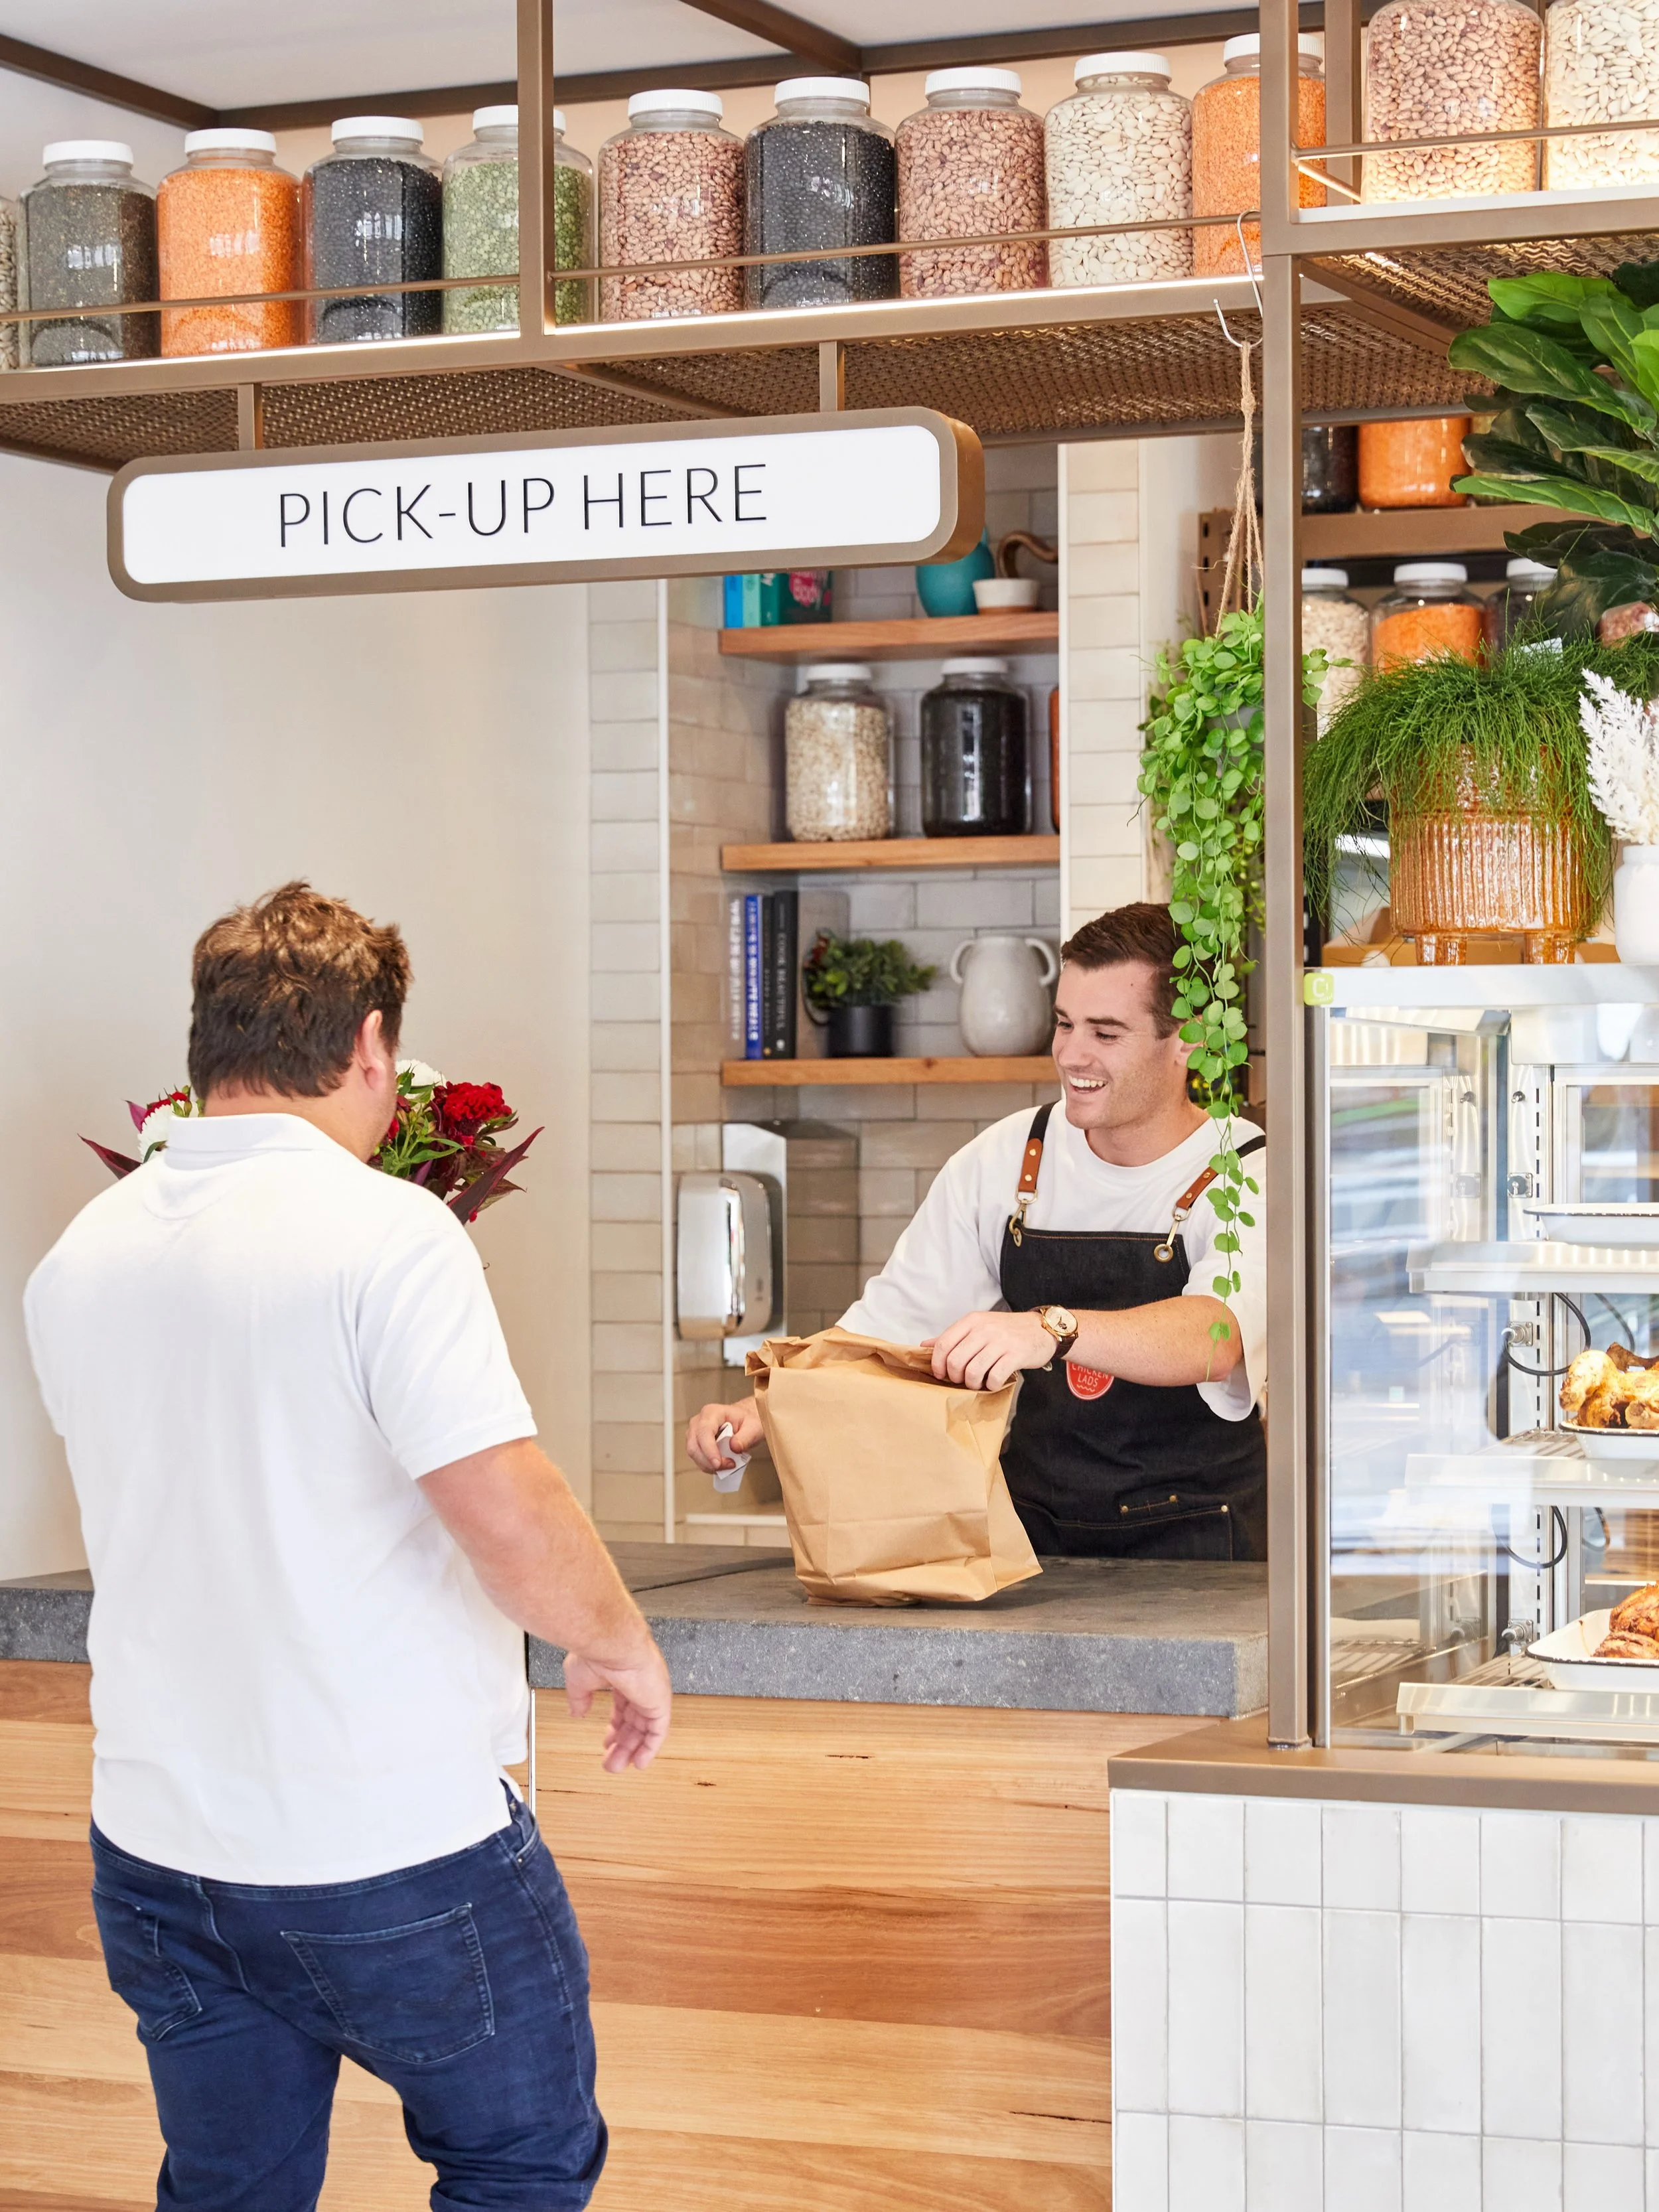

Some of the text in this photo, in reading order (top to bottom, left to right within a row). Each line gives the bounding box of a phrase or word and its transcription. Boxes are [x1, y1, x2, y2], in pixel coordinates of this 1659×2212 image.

[279, 464, 767, 548] PICK-UP HERE
[1078, 1373, 1098, 1387] LADS
